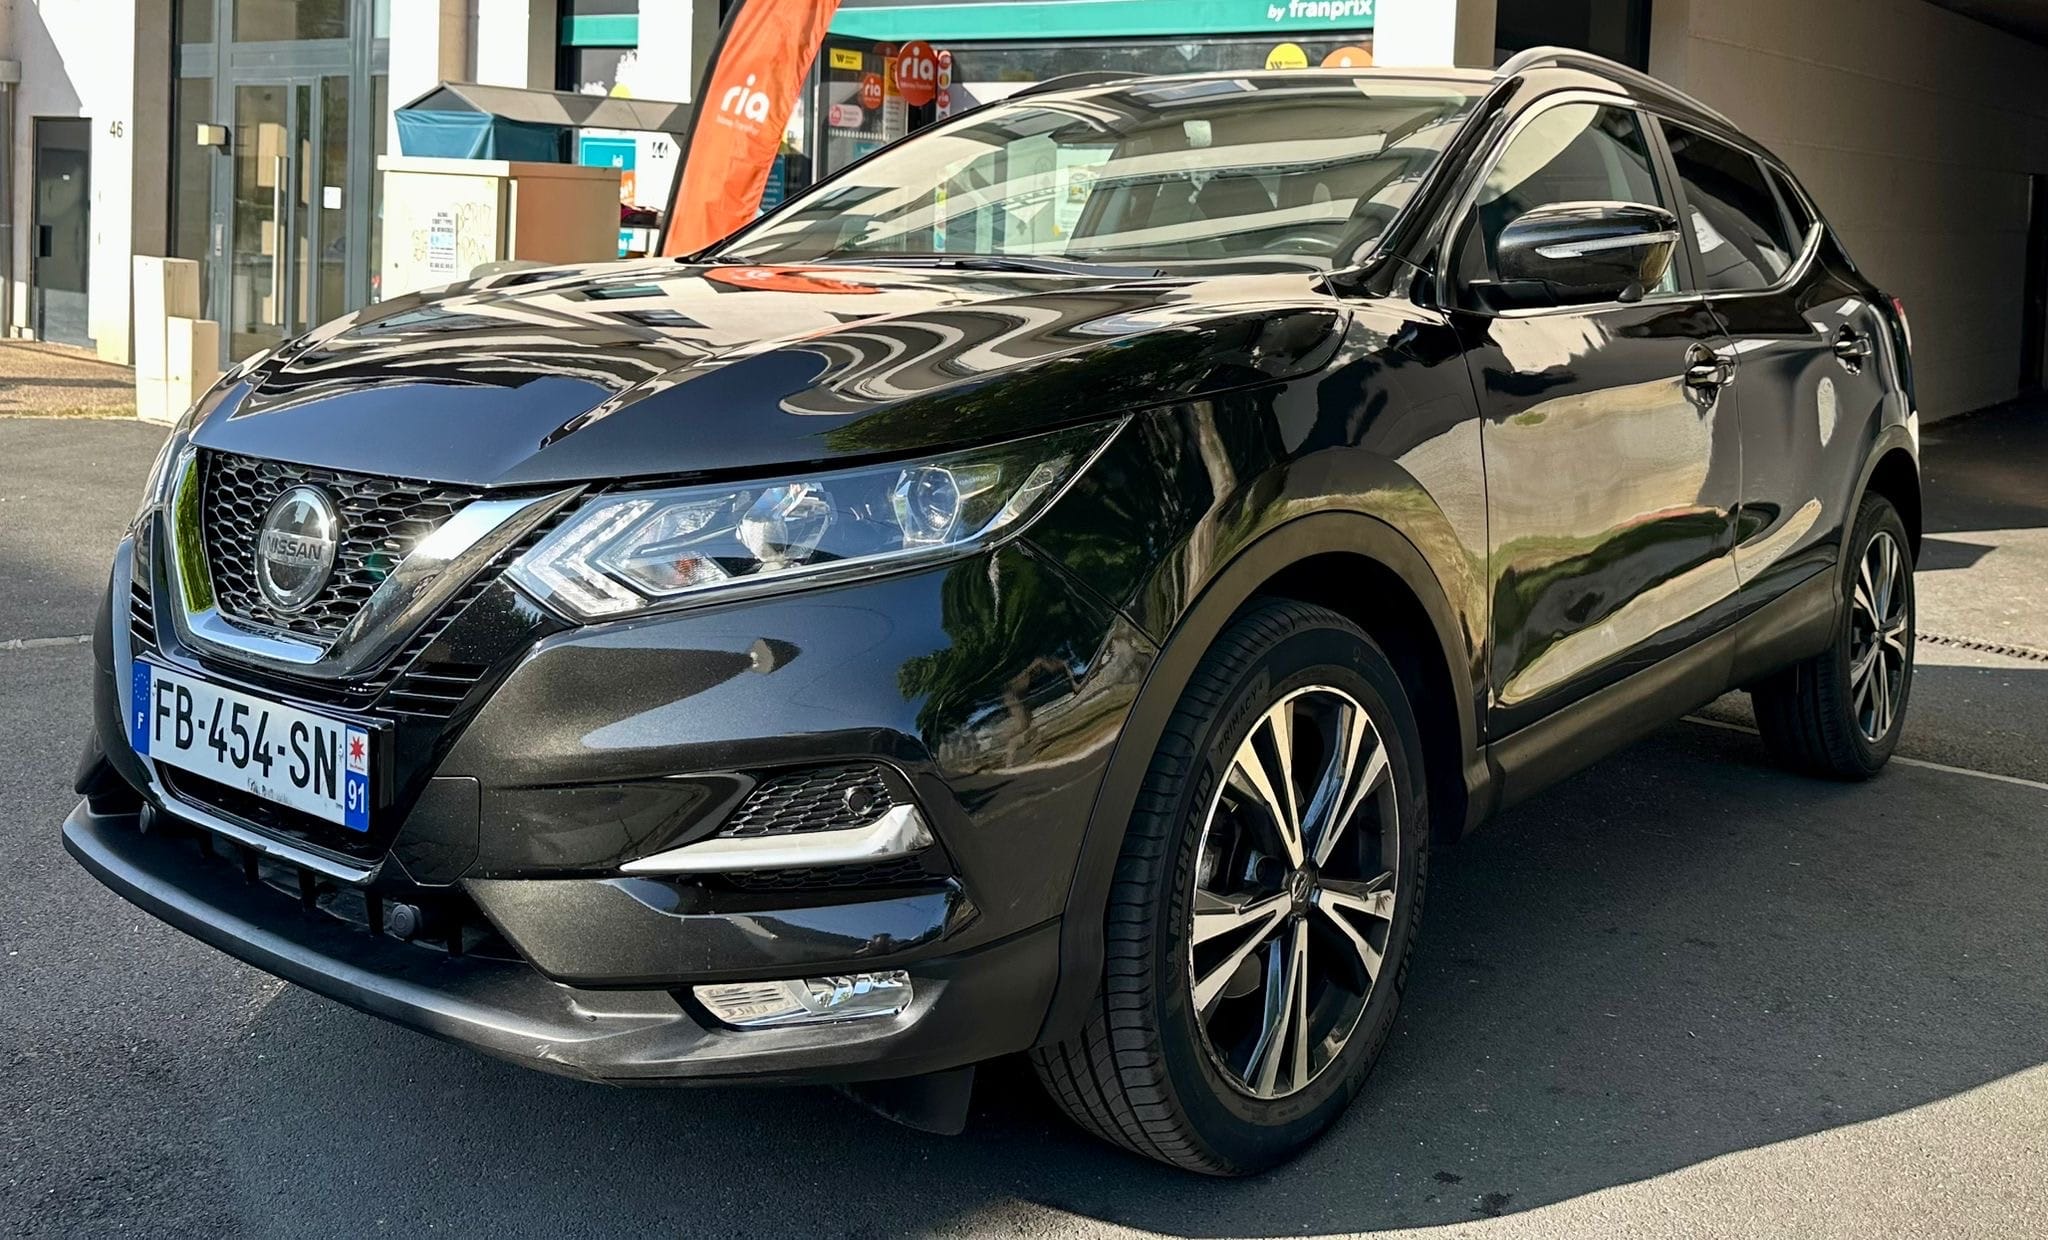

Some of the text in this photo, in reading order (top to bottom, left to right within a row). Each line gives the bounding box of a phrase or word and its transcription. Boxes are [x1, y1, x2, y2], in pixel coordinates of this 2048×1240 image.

[1267, 0, 1373, 22] by franprix
[901, 46, 934, 81] ria
[720, 73, 770, 124] ria
[864, 77, 881, 97] ria
[110, 120, 123, 138] 46
[267, 536, 322, 560] NISSAN
[137, 711, 145, 729] F
[1218, 688, 1257, 755] PRIMACY
[155, 678, 337, 801] FB-454-SN
[348, 779, 365, 814] 91
[1168, 768, 1212, 937] MICHELIN
